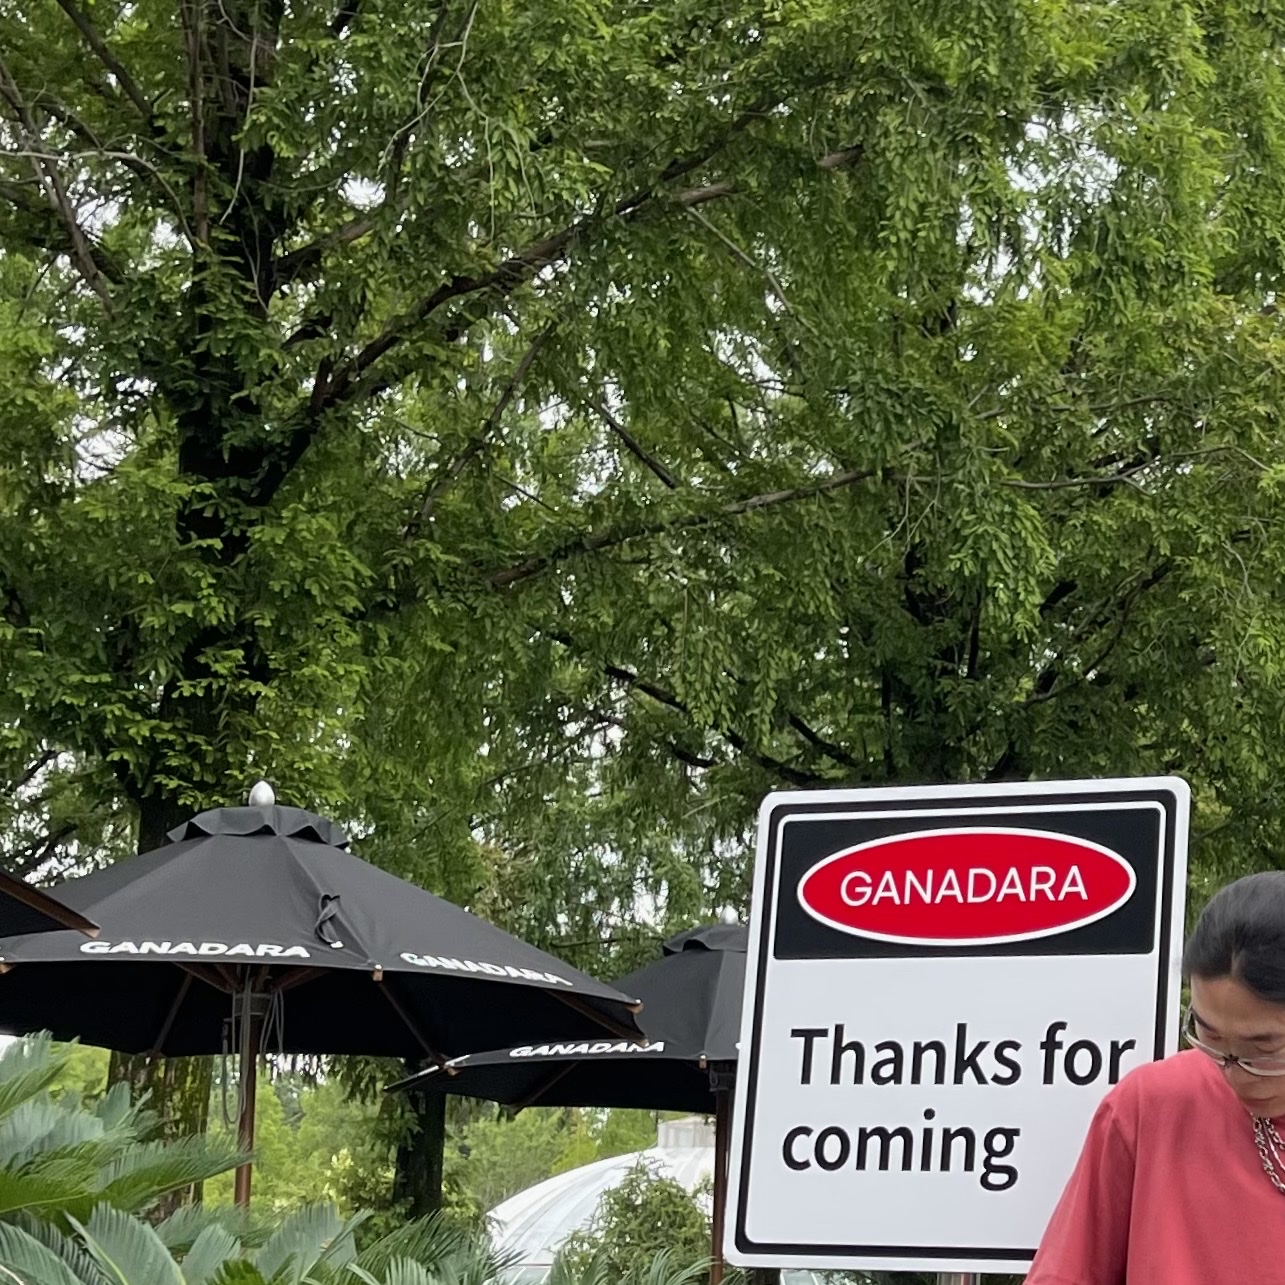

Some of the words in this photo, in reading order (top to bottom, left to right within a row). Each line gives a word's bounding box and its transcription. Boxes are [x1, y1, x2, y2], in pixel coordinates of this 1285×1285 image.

[839, 864, 1089, 907] GANADARA
[80, 941, 311, 958] GANADARA
[790, 1023, 1022, 1087] Thanks
[1039, 1021, 1136, 1087] for
[782, 1108, 1021, 1192] coming
